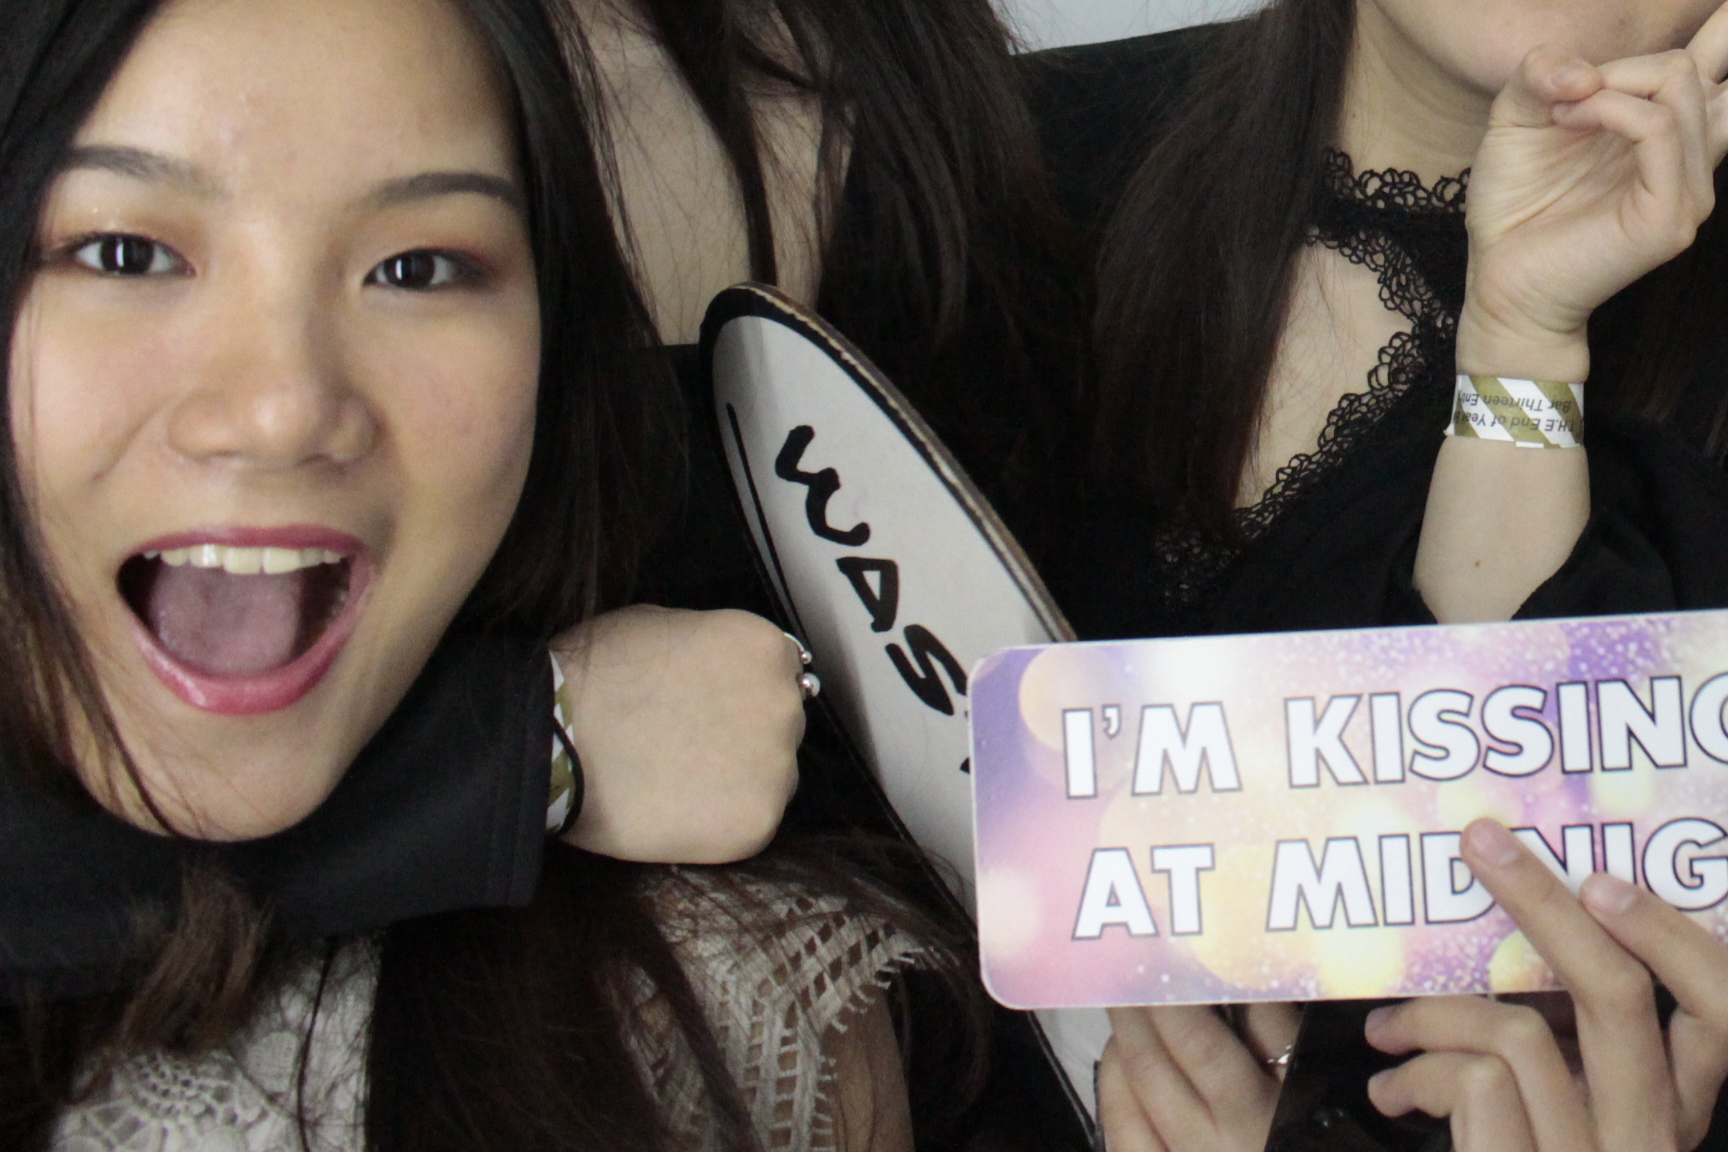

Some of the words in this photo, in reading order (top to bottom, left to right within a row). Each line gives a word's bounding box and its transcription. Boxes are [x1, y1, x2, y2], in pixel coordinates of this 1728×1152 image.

[1483, 394, 1543, 412] Thirteen
[1547, 400, 1572, 414] Bar
[1490, 414, 1507, 427] of
[1510, 416, 1542, 431] End
[1071, 843, 1216, 941] AT
